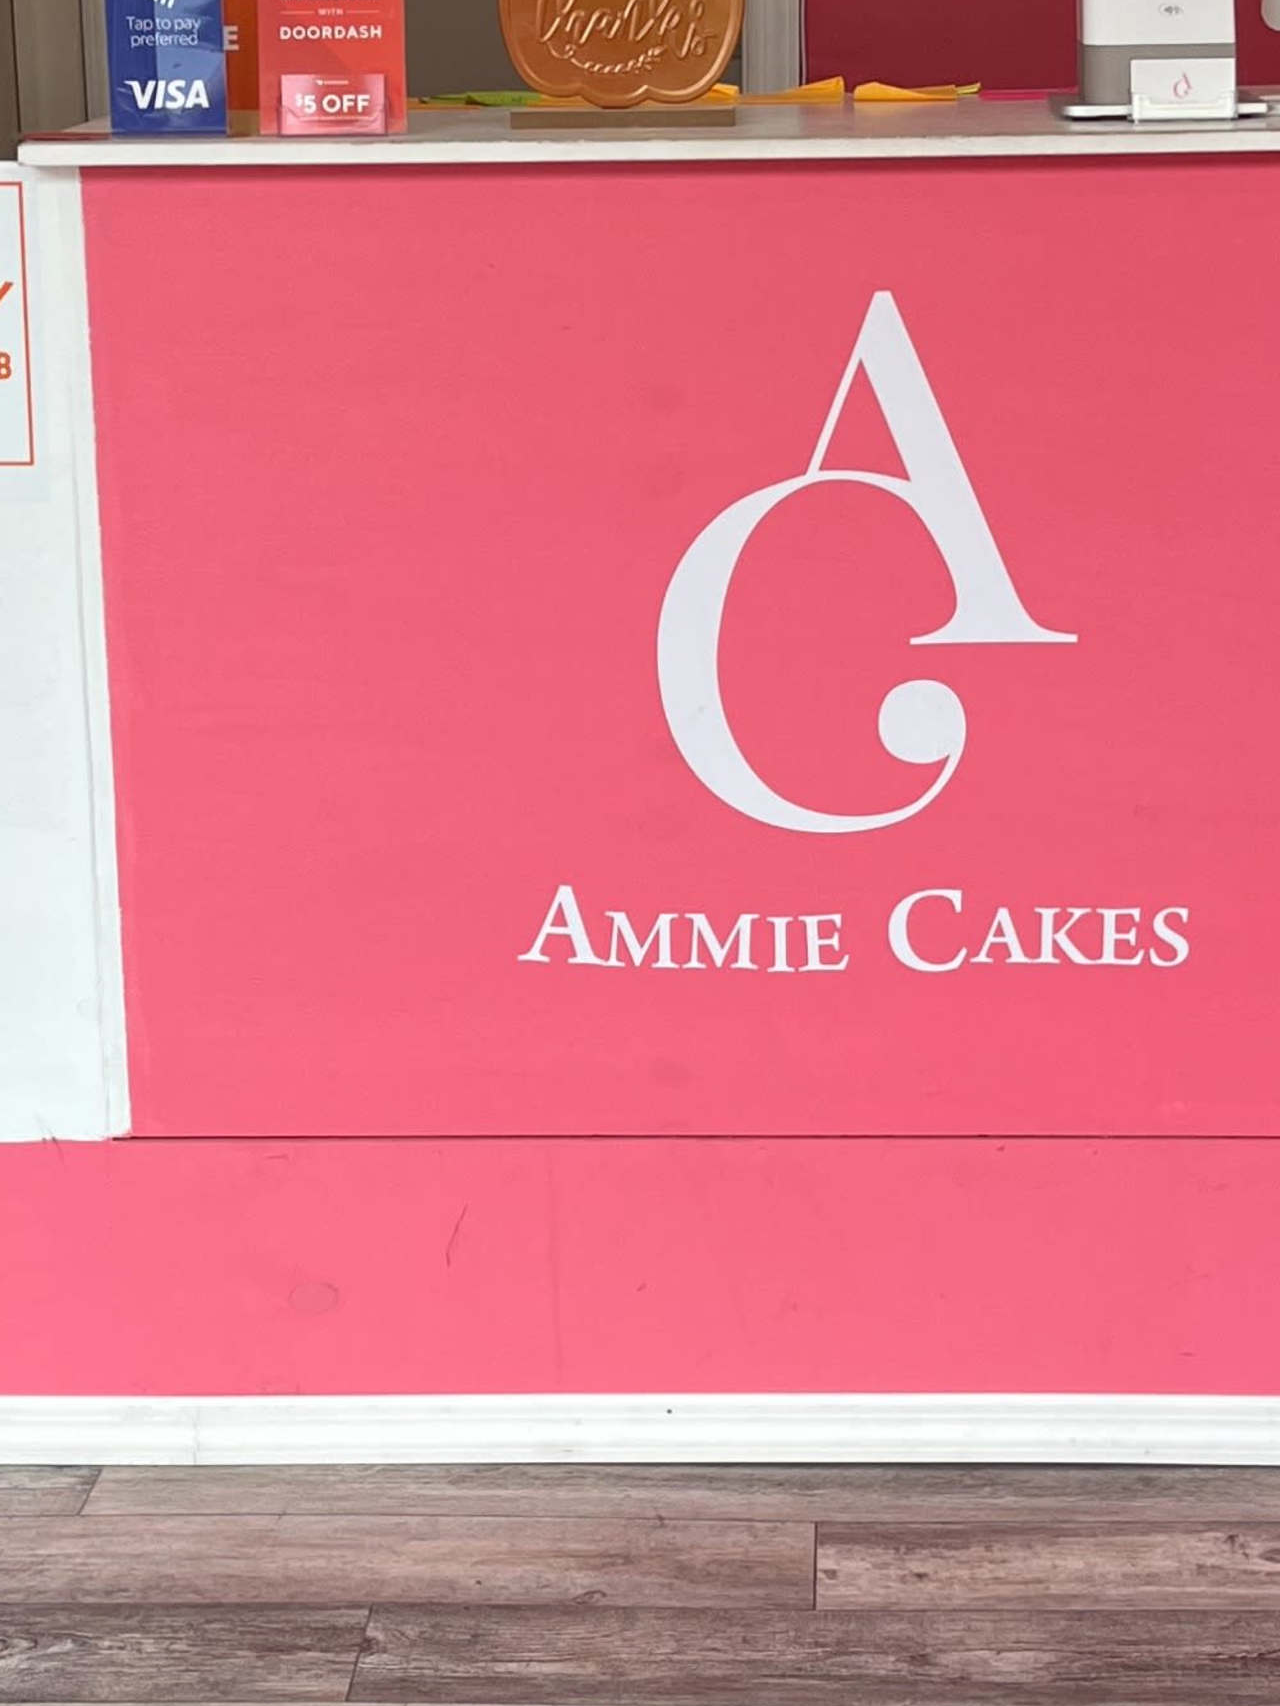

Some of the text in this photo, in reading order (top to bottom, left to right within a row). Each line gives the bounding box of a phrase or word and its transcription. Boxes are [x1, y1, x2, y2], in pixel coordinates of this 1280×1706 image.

[126, 16, 201, 34] Tap to pay
[279, 25, 383, 40] DOORDASH
[131, 30, 198, 48] preferred
[124, 79, 210, 109] VISA
[322, 94, 370, 113] OFF
